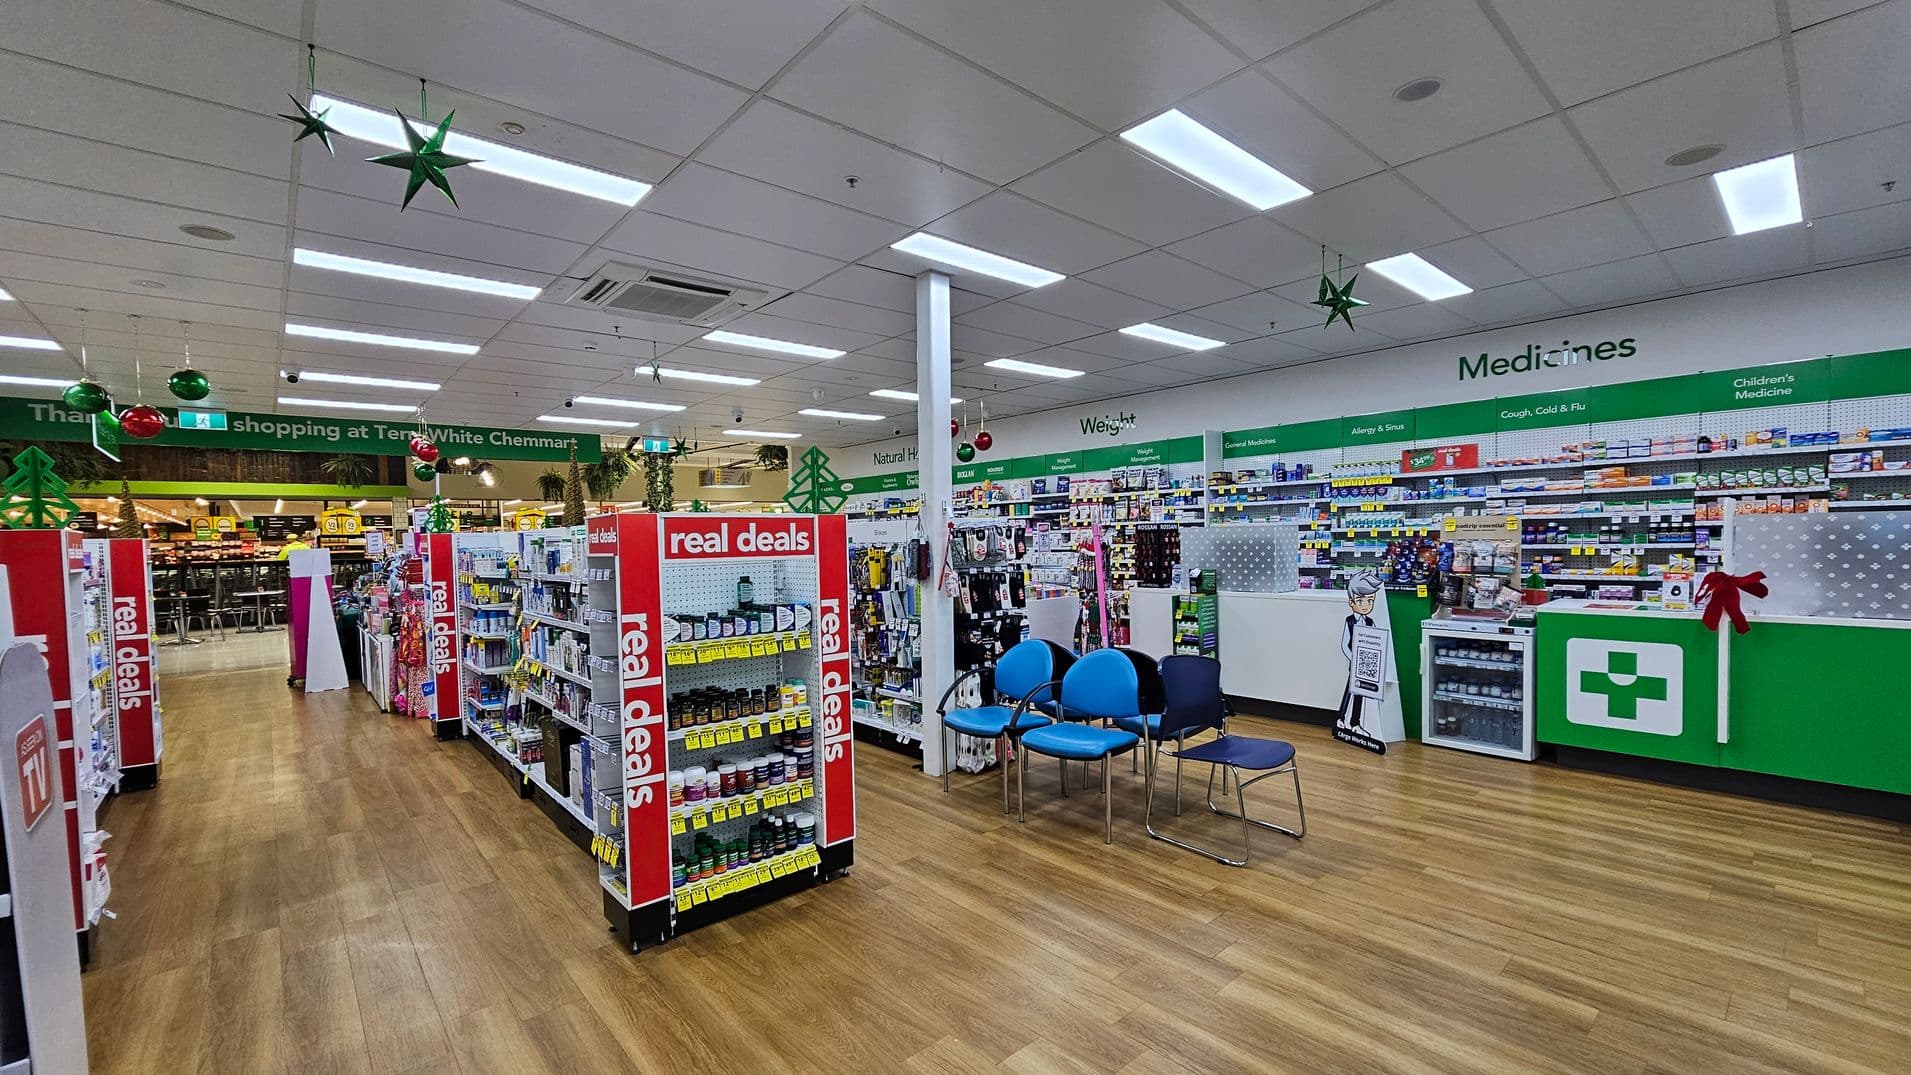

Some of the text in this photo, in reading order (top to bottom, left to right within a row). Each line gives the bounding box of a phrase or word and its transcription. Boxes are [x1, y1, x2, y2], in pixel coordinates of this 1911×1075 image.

[1459, 338, 1637, 381] Medicines
[1733, 374, 1795, 388] Children's
[1735, 387, 1793, 400] Medicine
[27, 403, 92, 424] Tha
[233, 416, 341, 441] shopping
[347, 427, 369, 439] at
[489, 431, 578, 449] Chemmart
[1080, 411, 1137, 436] Weight
[1501, 402, 1586, 419] Cough, Cold & Flu
[1225, 437, 1277, 449] General Medicines
[1351, 425, 1376, 435] Allergy
[1385, 423, 1405, 432] Sinus
[874, 447, 906, 466] Natural
[671, 523, 810, 554] real deals
[432, 581, 457, 675] real deals
[114, 596, 151, 711] real deals
[821, 598, 852, 763] real deals
[621, 613, 665, 809] real deals
[23, 747, 46, 814] TV
